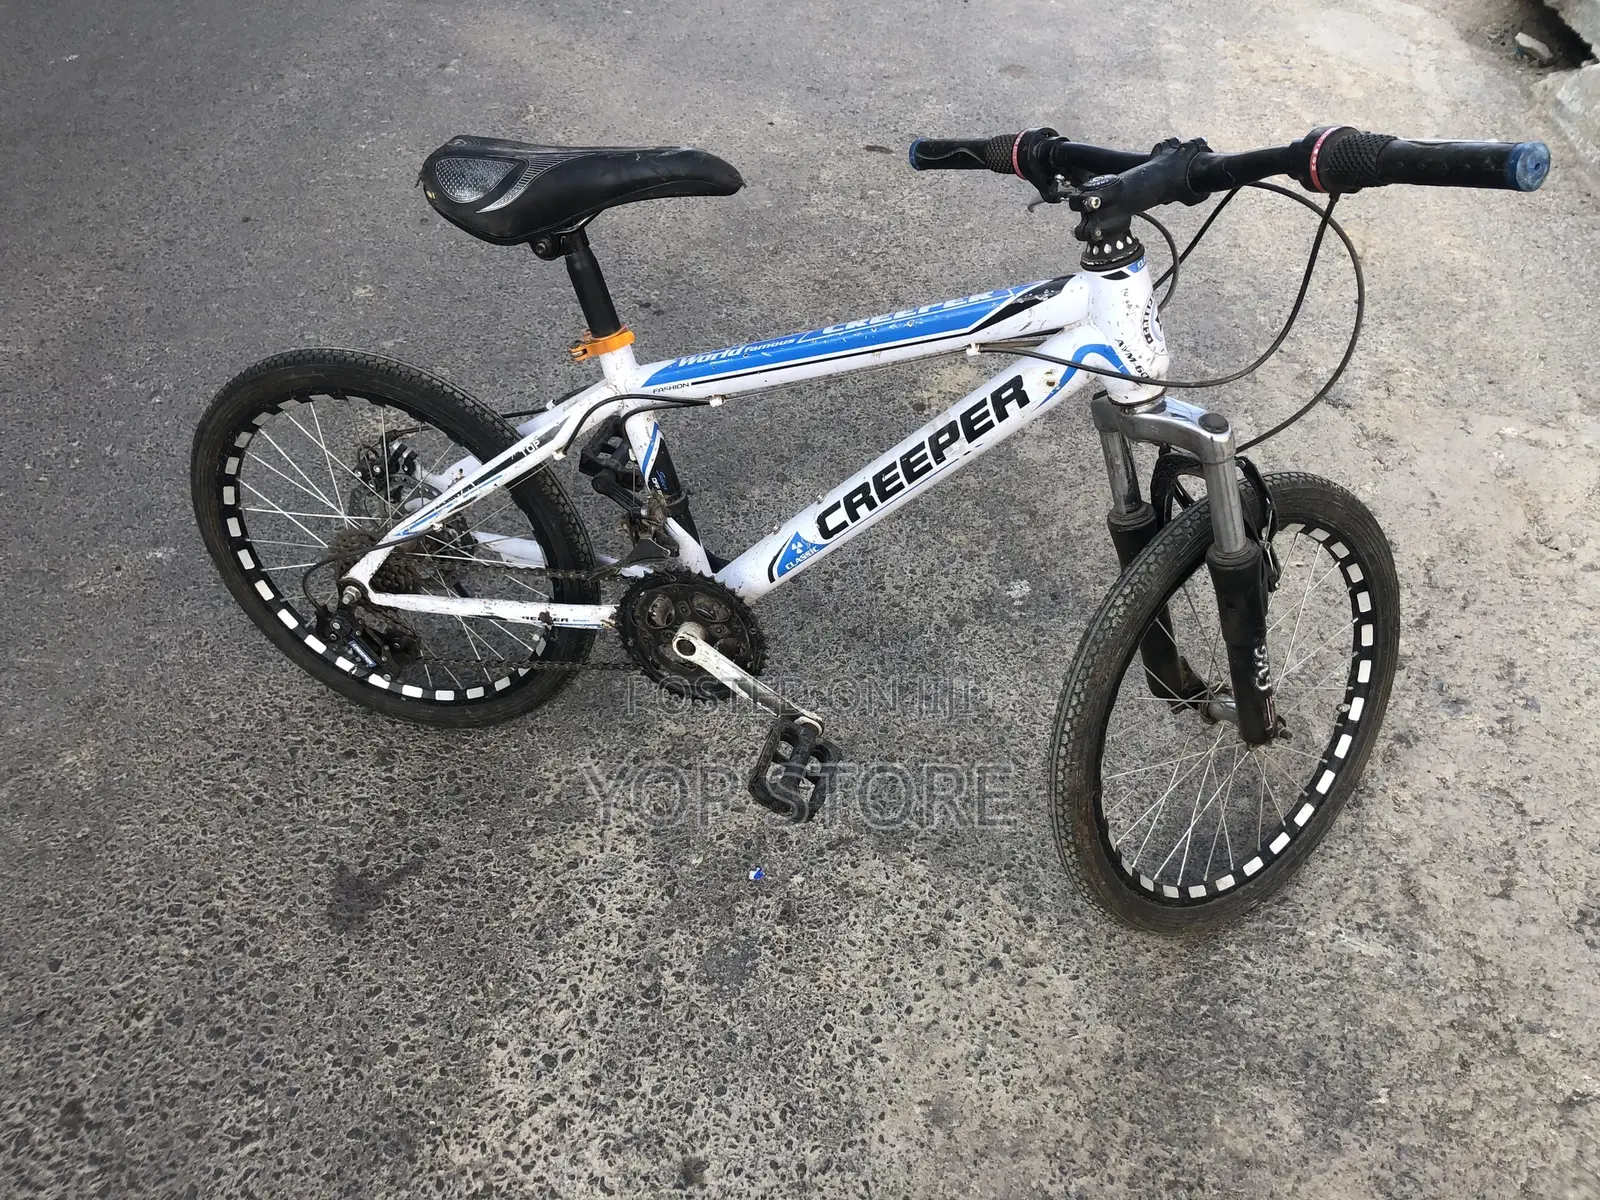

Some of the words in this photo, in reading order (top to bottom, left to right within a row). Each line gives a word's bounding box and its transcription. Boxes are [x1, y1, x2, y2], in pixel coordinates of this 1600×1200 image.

[678, 344, 747, 367] World
[744, 338, 796, 353] famous
[652, 382, 690, 394] FASHION
[816, 374, 1031, 540] CREEPER
[784, 545, 820, 570] CLASSIC
